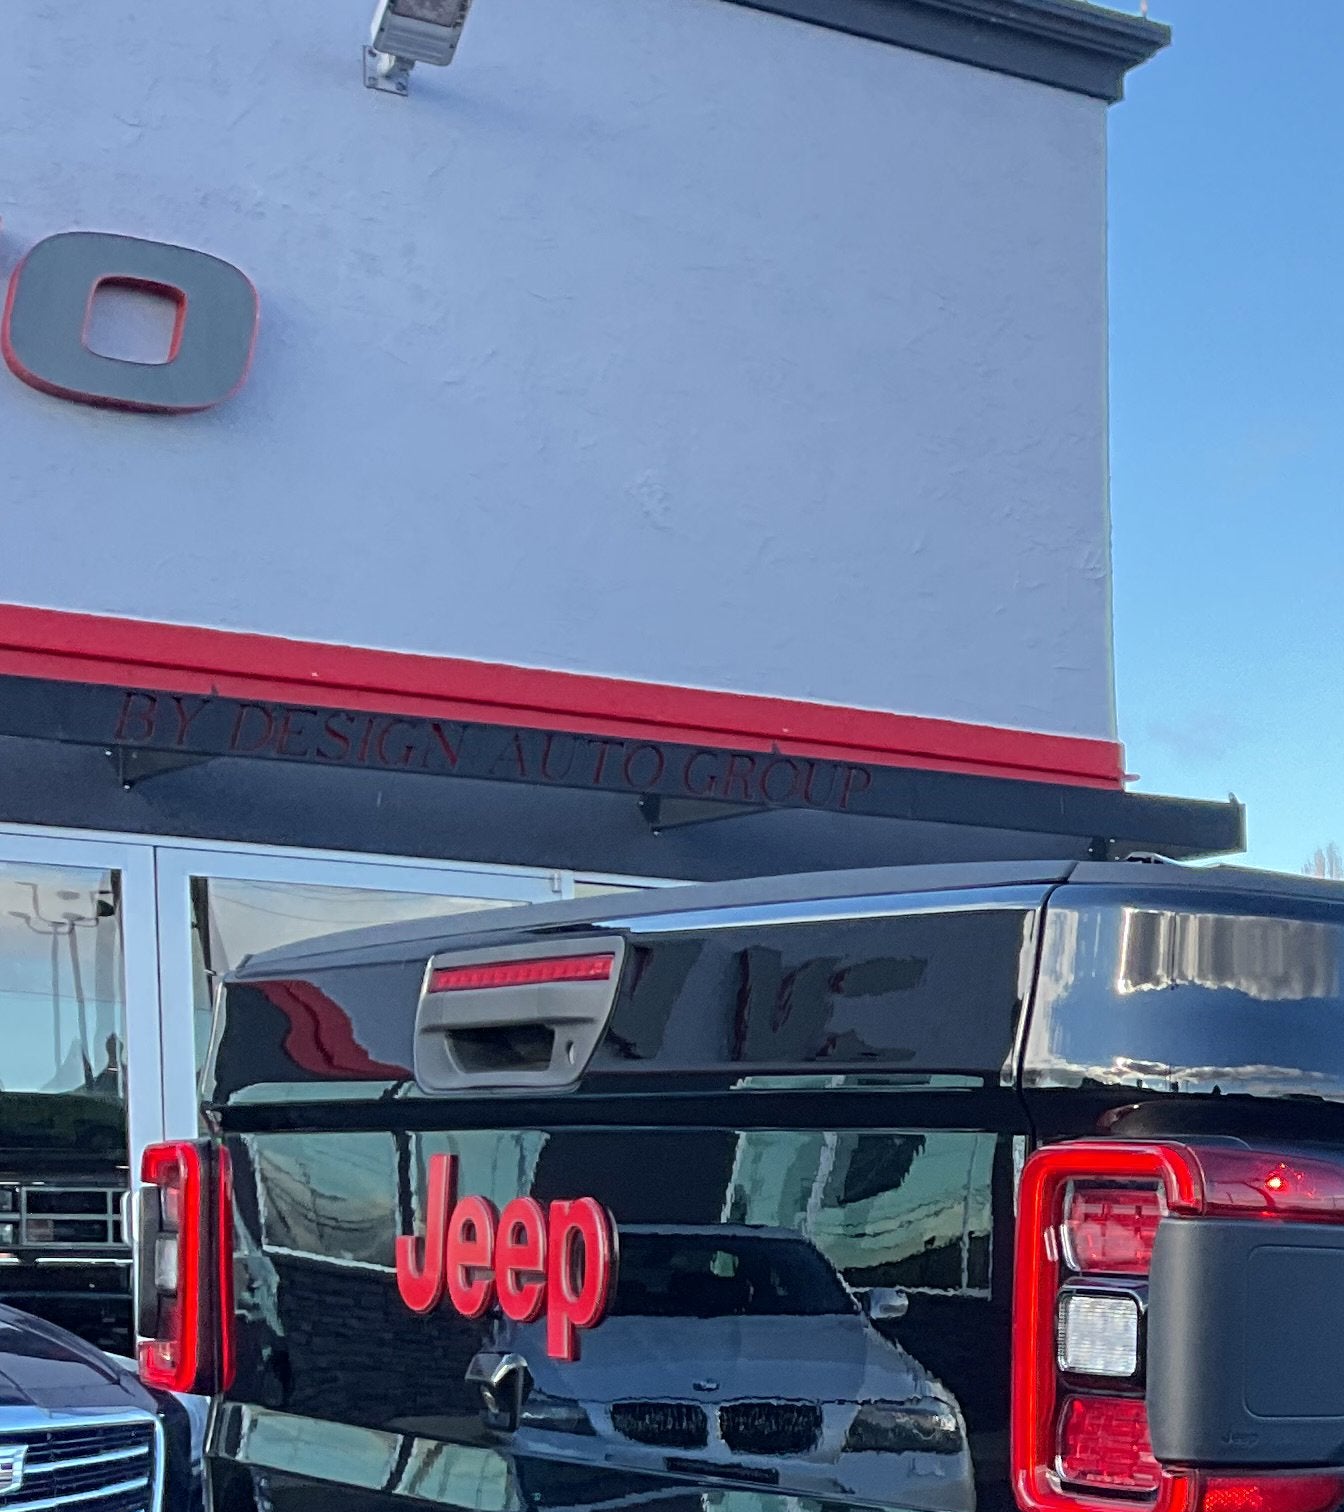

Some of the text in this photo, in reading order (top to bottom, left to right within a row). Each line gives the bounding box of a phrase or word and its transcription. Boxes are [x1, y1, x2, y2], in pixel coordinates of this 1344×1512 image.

[114, 690, 873, 809] BY DESIGN AUTO GROUP
[395, 1153, 619, 1362] Jeep
